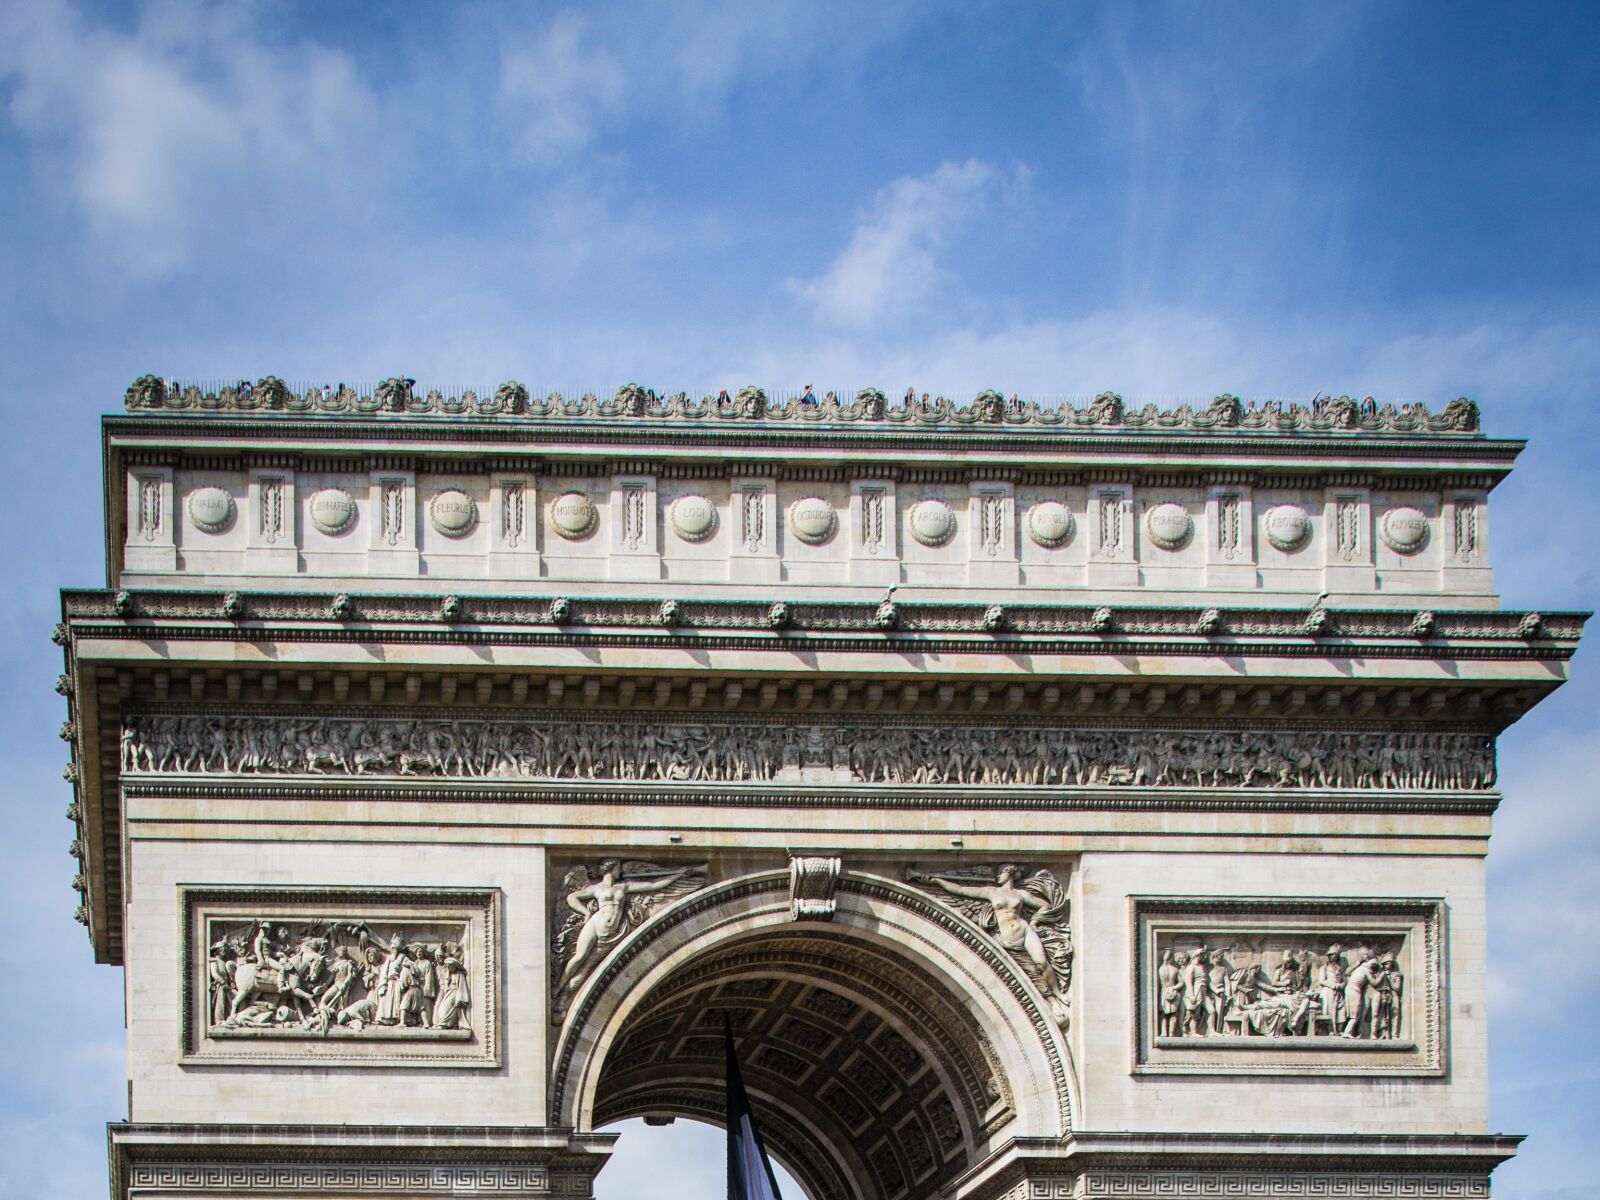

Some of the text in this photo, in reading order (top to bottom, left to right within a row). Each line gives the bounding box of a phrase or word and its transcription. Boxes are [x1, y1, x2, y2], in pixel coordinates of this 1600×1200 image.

[436, 503, 469, 514] FLEURUS
[683, 507, 705, 519] LODI
[917, 512, 948, 523] ARCOLE
[1037, 513, 1067, 524] RIVOLI
